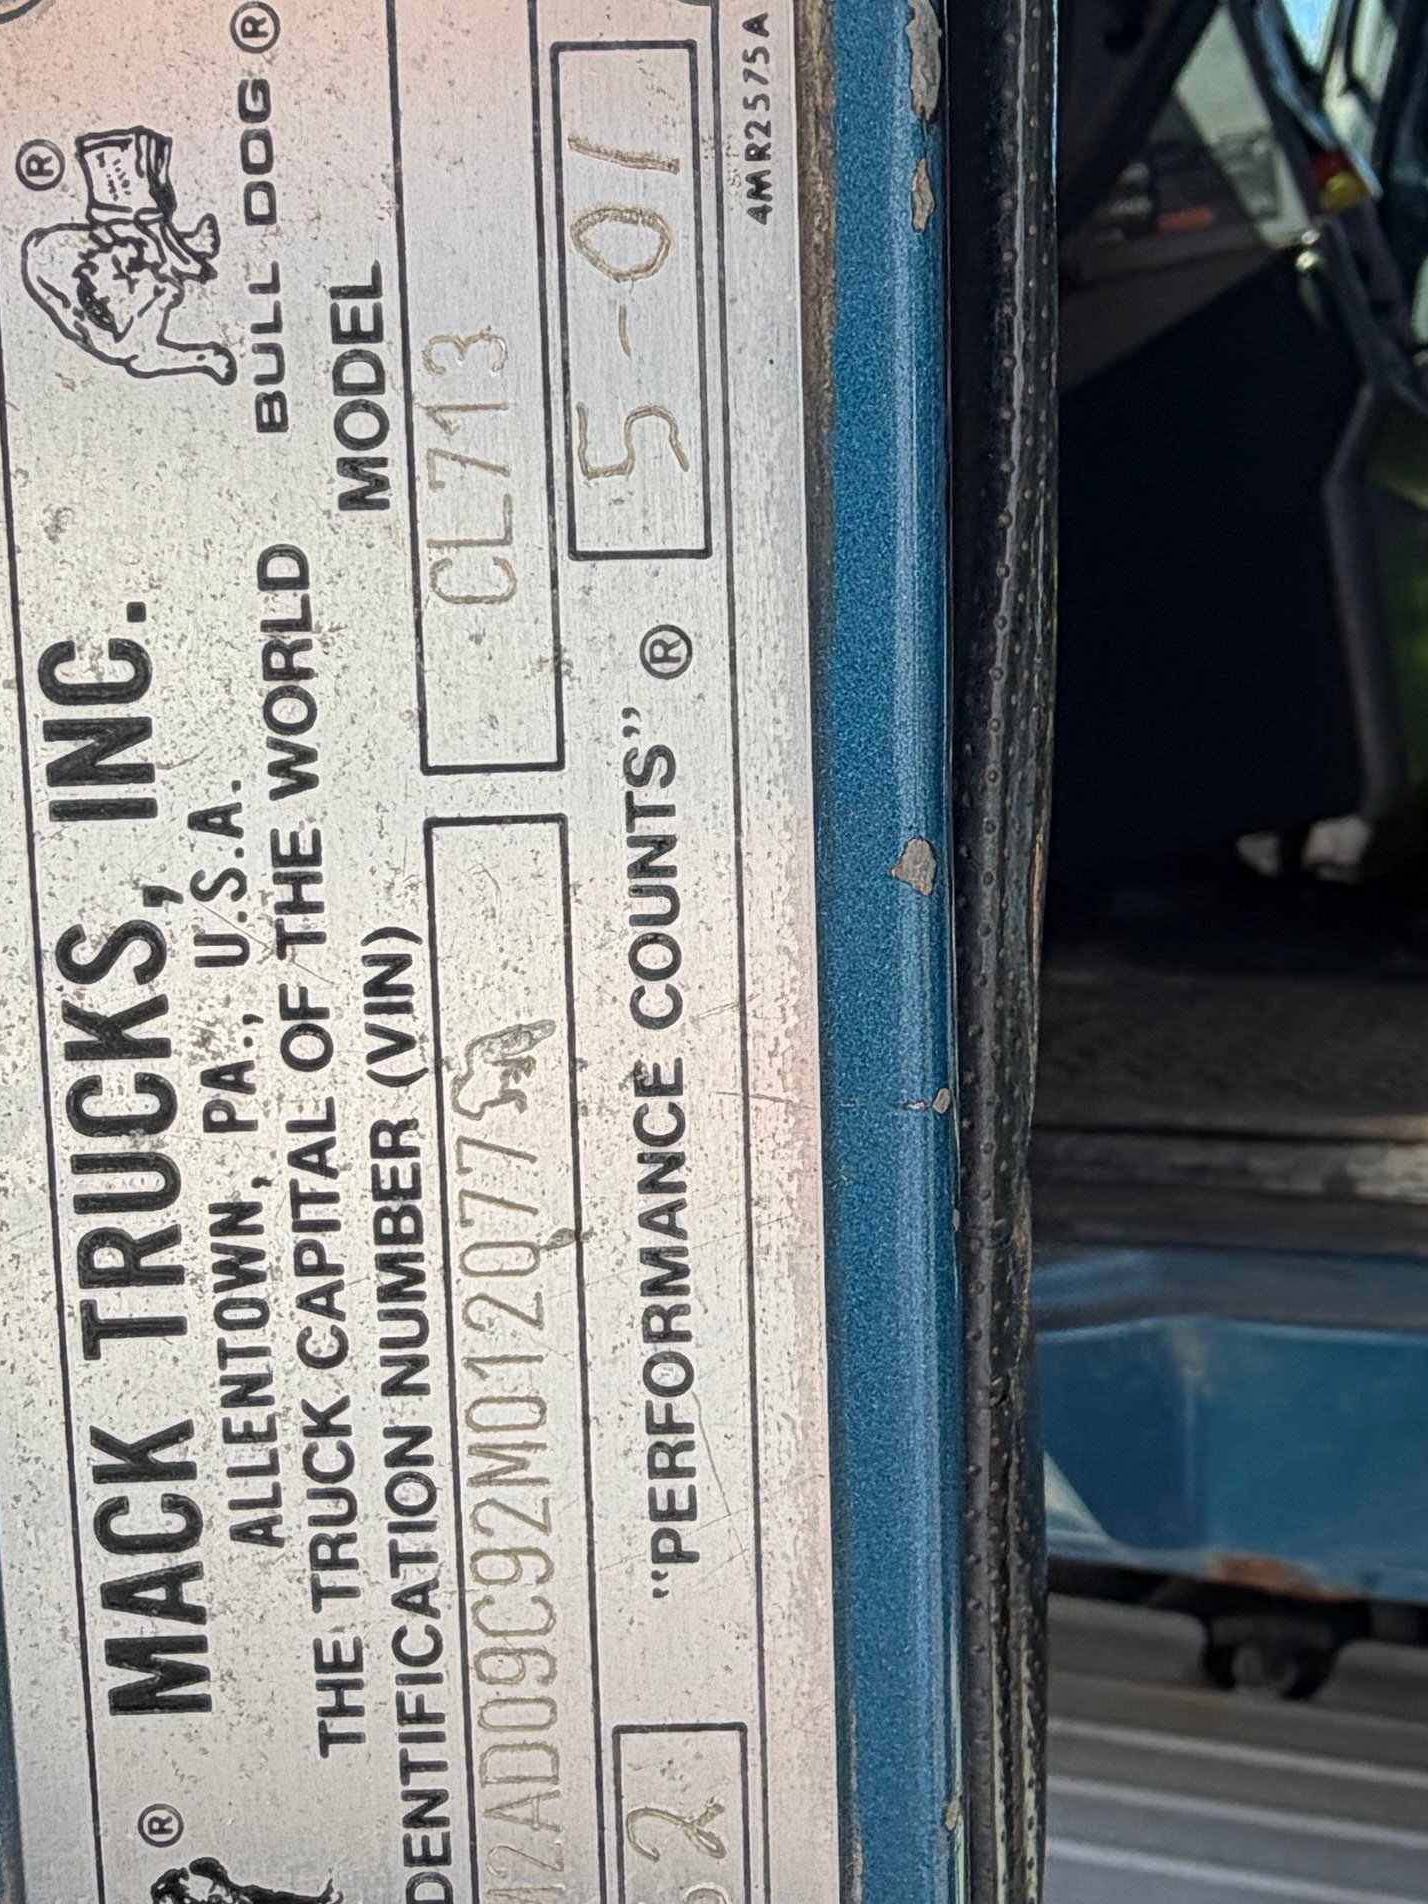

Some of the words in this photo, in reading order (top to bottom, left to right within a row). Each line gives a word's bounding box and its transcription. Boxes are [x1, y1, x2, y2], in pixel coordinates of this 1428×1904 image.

[238, 79, 277, 226] DOG
[741, 14, 773, 225] 4MR2575A
[247, 262, 289, 432] BULL
[330, 262, 390, 511] MODEL
[567, 134, 689, 480] 5-01
[423, 330, 516, 606] CL713
[38, 601, 158, 822] INC.
[257, 544, 319, 801] WORLD
[186, 780, 251, 968] U.S.A.
[271, 828, 326, 960] THE
[622, 706, 682, 1030] COUNTS"
[54, 884, 189, 1360] TRUCKS,
[198, 1012, 264, 1133] PA.,
[279, 984, 334, 1072] OF
[360, 927, 422, 1088] (VIN)
[286, 1095, 350, 1370] CAPITAL
[369, 1119, 433, 1396] NUMBER
[633, 1058, 700, 1598] "PERFORMANCE
[208, 1176, 285, 1548] ALLENTOWN,
[86, 1420, 214, 1715] MACK
[299, 1397, 361, 1612] TRUCK
[314, 1636, 367, 1758] THE
